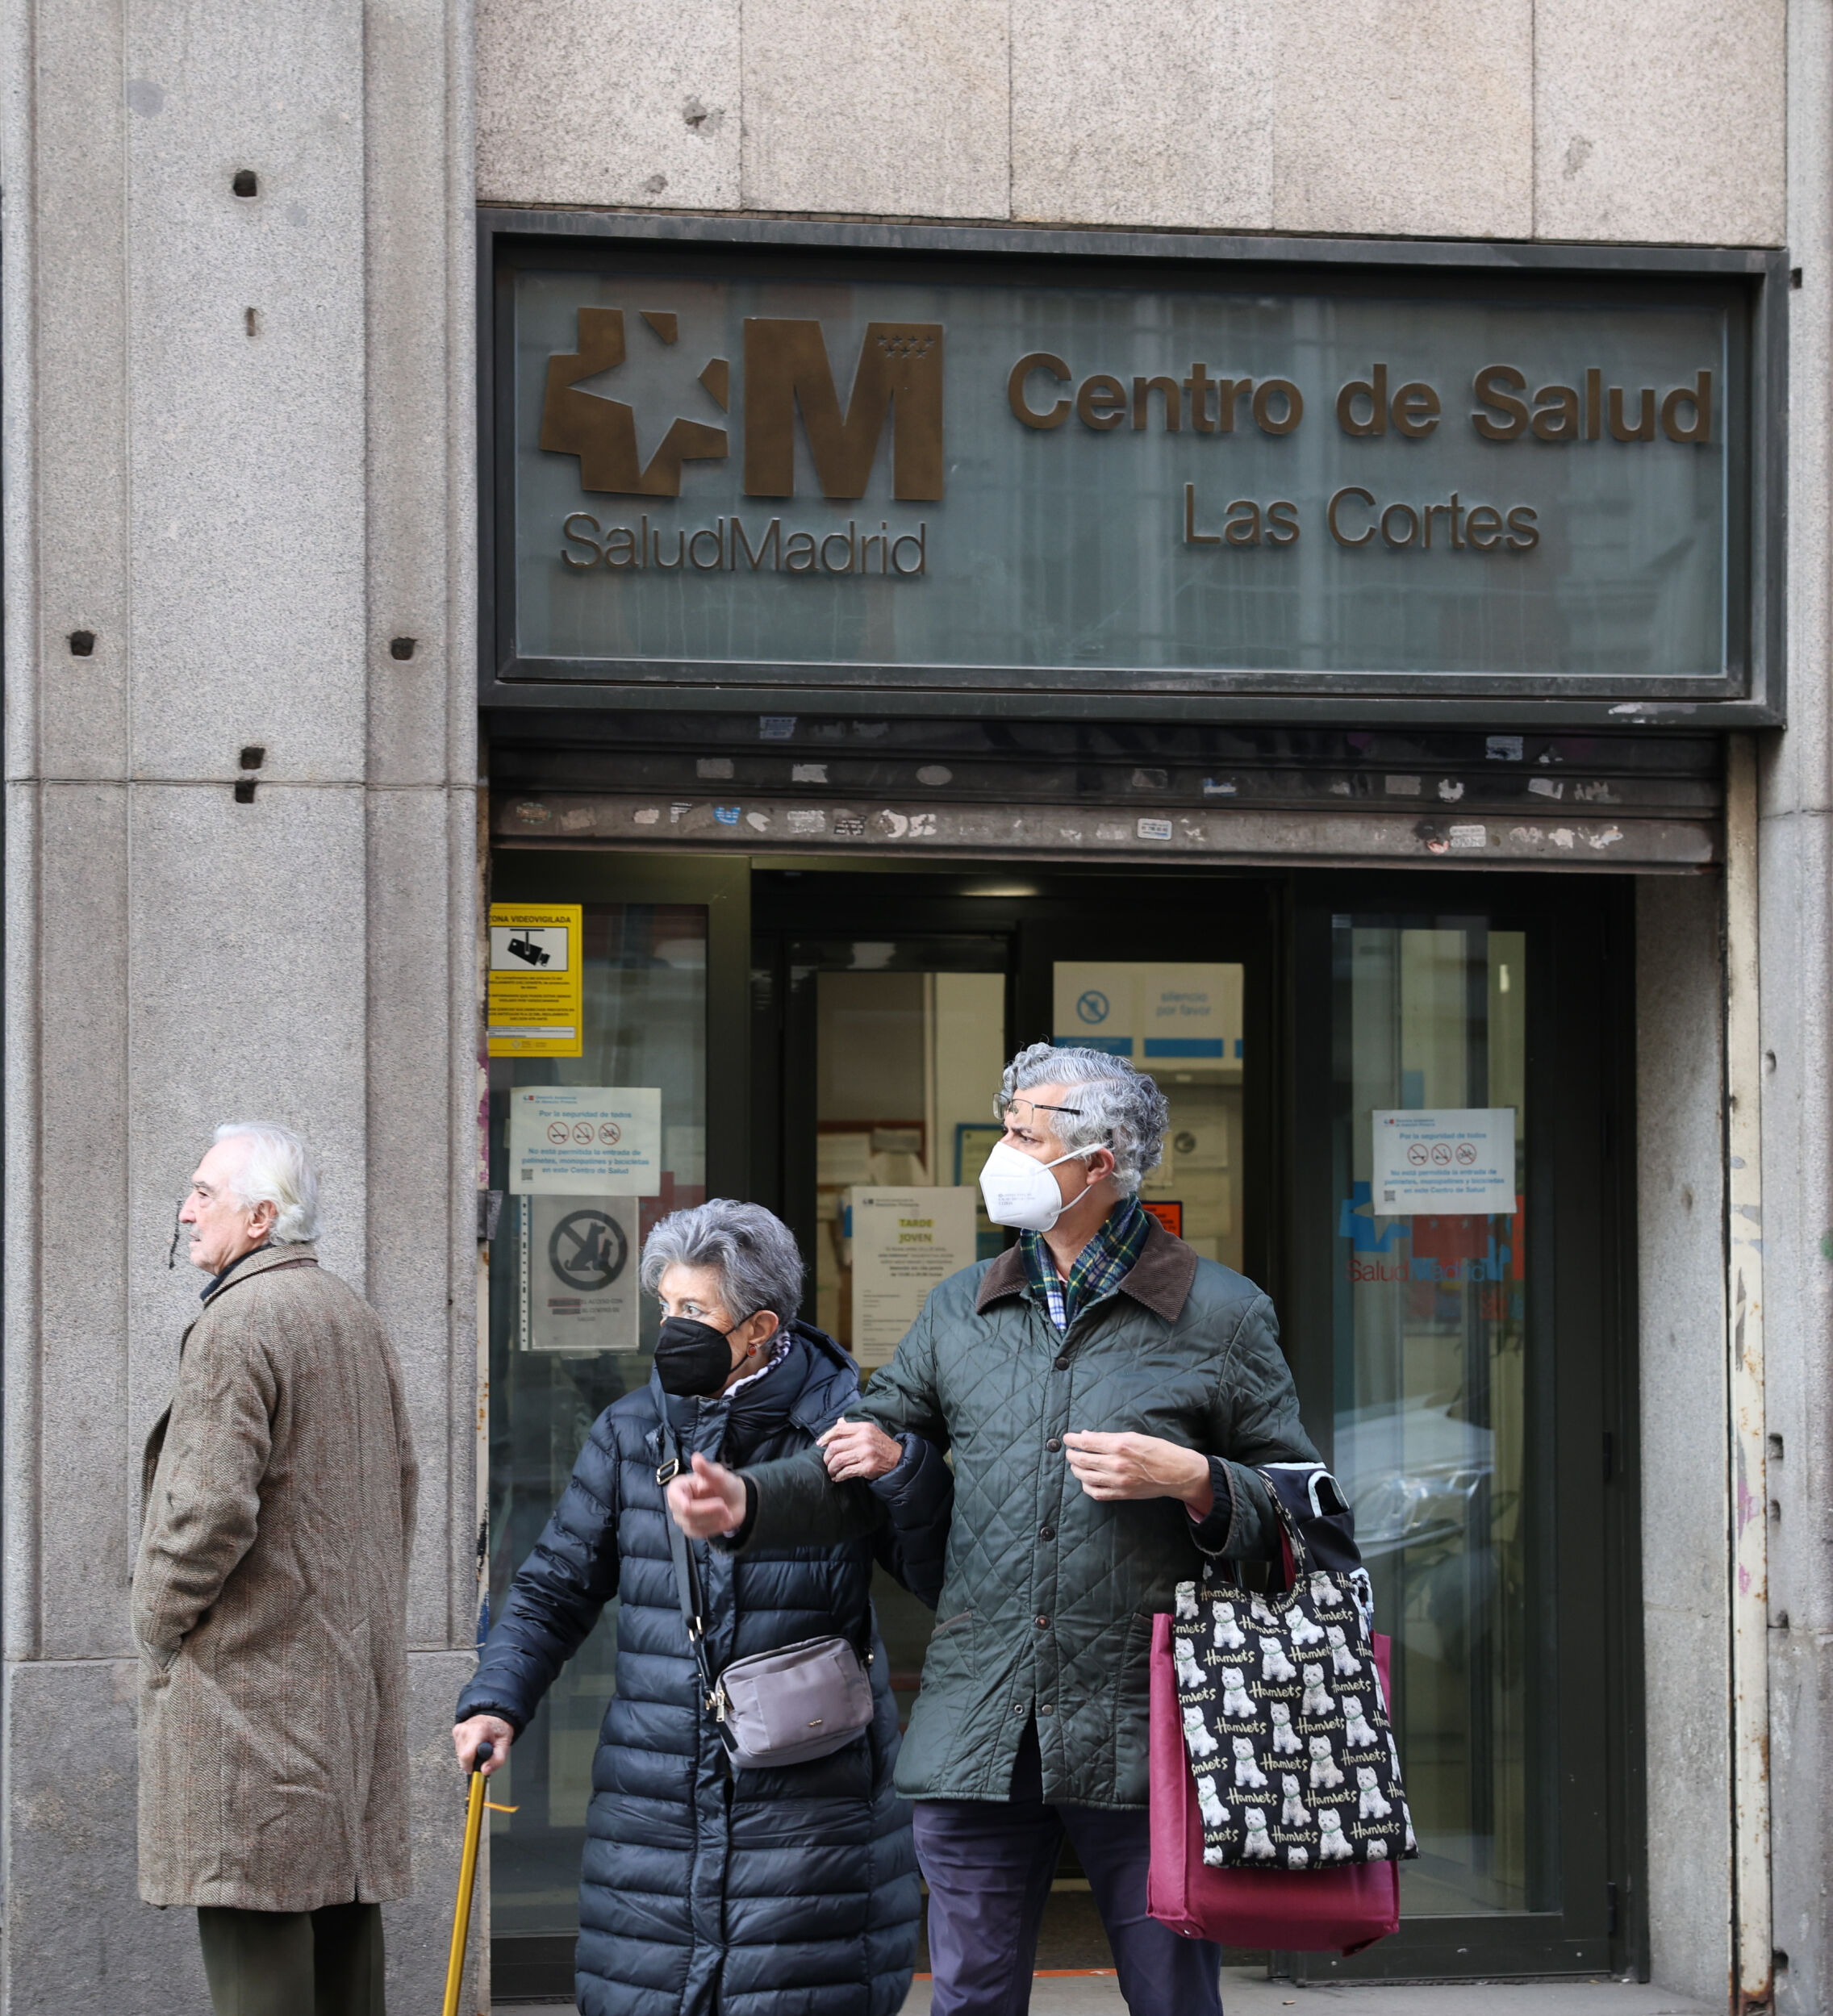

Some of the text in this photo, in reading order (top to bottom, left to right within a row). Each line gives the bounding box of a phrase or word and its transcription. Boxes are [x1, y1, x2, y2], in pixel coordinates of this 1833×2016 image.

[1008, 352, 1713, 443] Centro de Salud
[1183, 482, 1540, 551] Las Cortes
[561, 512, 926, 576] SaludMadrid
[1161, 991, 1208, 1002] silencio
[1156, 1005, 1212, 1016] por favor
[562, 1111, 598, 1119] seguridad
[899, 1219, 933, 1227] TARDE
[899, 1233, 933, 1243] JOVEN
